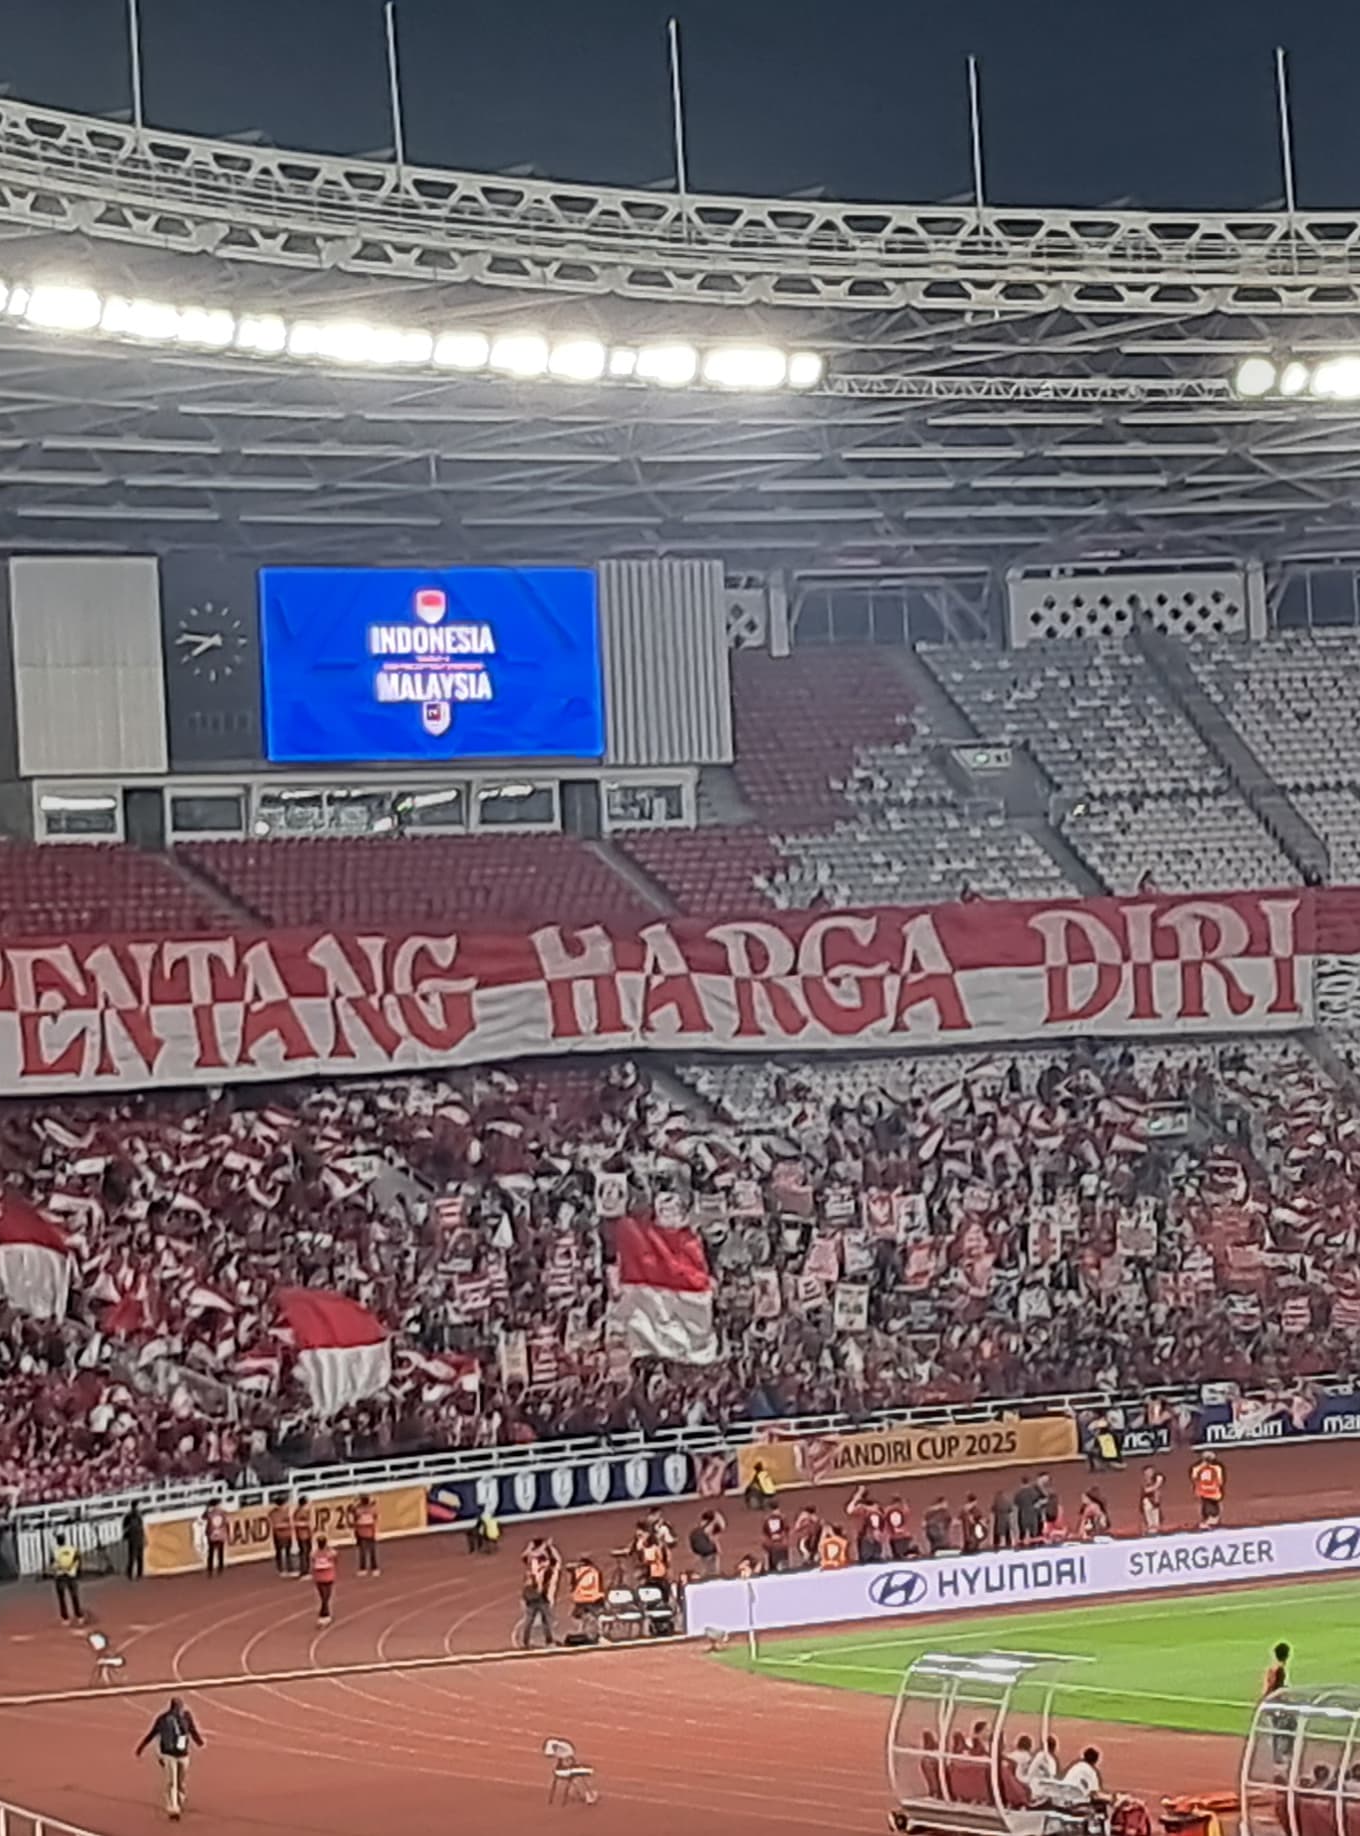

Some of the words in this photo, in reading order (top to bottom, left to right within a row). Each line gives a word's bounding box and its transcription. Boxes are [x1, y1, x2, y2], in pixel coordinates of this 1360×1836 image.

[371, 624, 495, 654] INDONESIA
[376, 671, 493, 701] MALAYSIA
[529, 912, 973, 1038] HARGA
[1027, 896, 1303, 1024] DIRI
[833, 1437, 911, 1469] ANDIRI
[916, 1434, 960, 1461] CUP
[964, 1430, 1018, 1457] 2025
[937, 1555, 1087, 1598] HYUNDAI
[1128, 1539, 1274, 1576] STARGAZER
